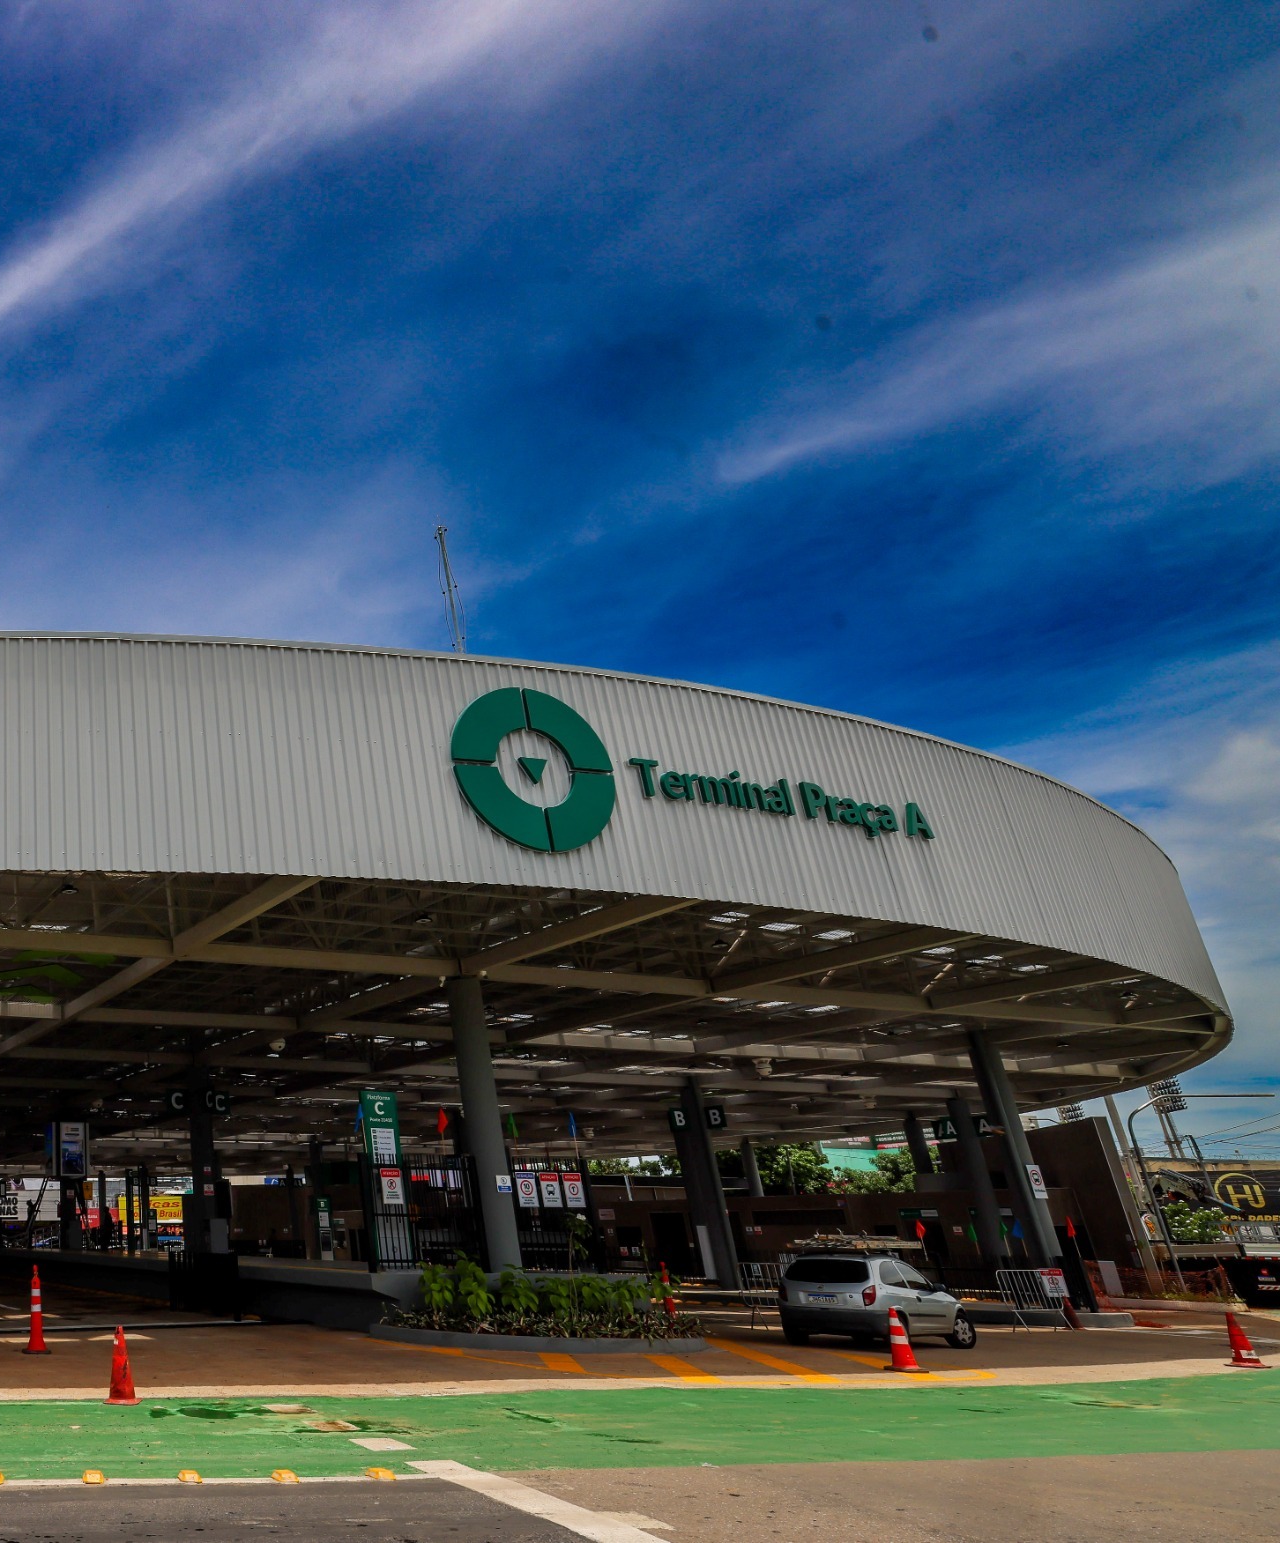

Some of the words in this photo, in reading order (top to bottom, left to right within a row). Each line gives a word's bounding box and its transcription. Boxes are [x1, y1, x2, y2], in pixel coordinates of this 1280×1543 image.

[629, 758, 796, 816] Terminal
[799, 781, 899, 839] Praça
[905, 802, 935, 840] A
[171, 1092, 185, 1110] C
[215, 1094, 227, 1111] C
[374, 1101, 385, 1115] C
[673, 1110, 686, 1126] B
[708, 1109, 722, 1125] B
[946, 1120, 957, 1134] A
[979, 1118, 991, 1133] A
[160, 1210, 182, 1218] Brasil
